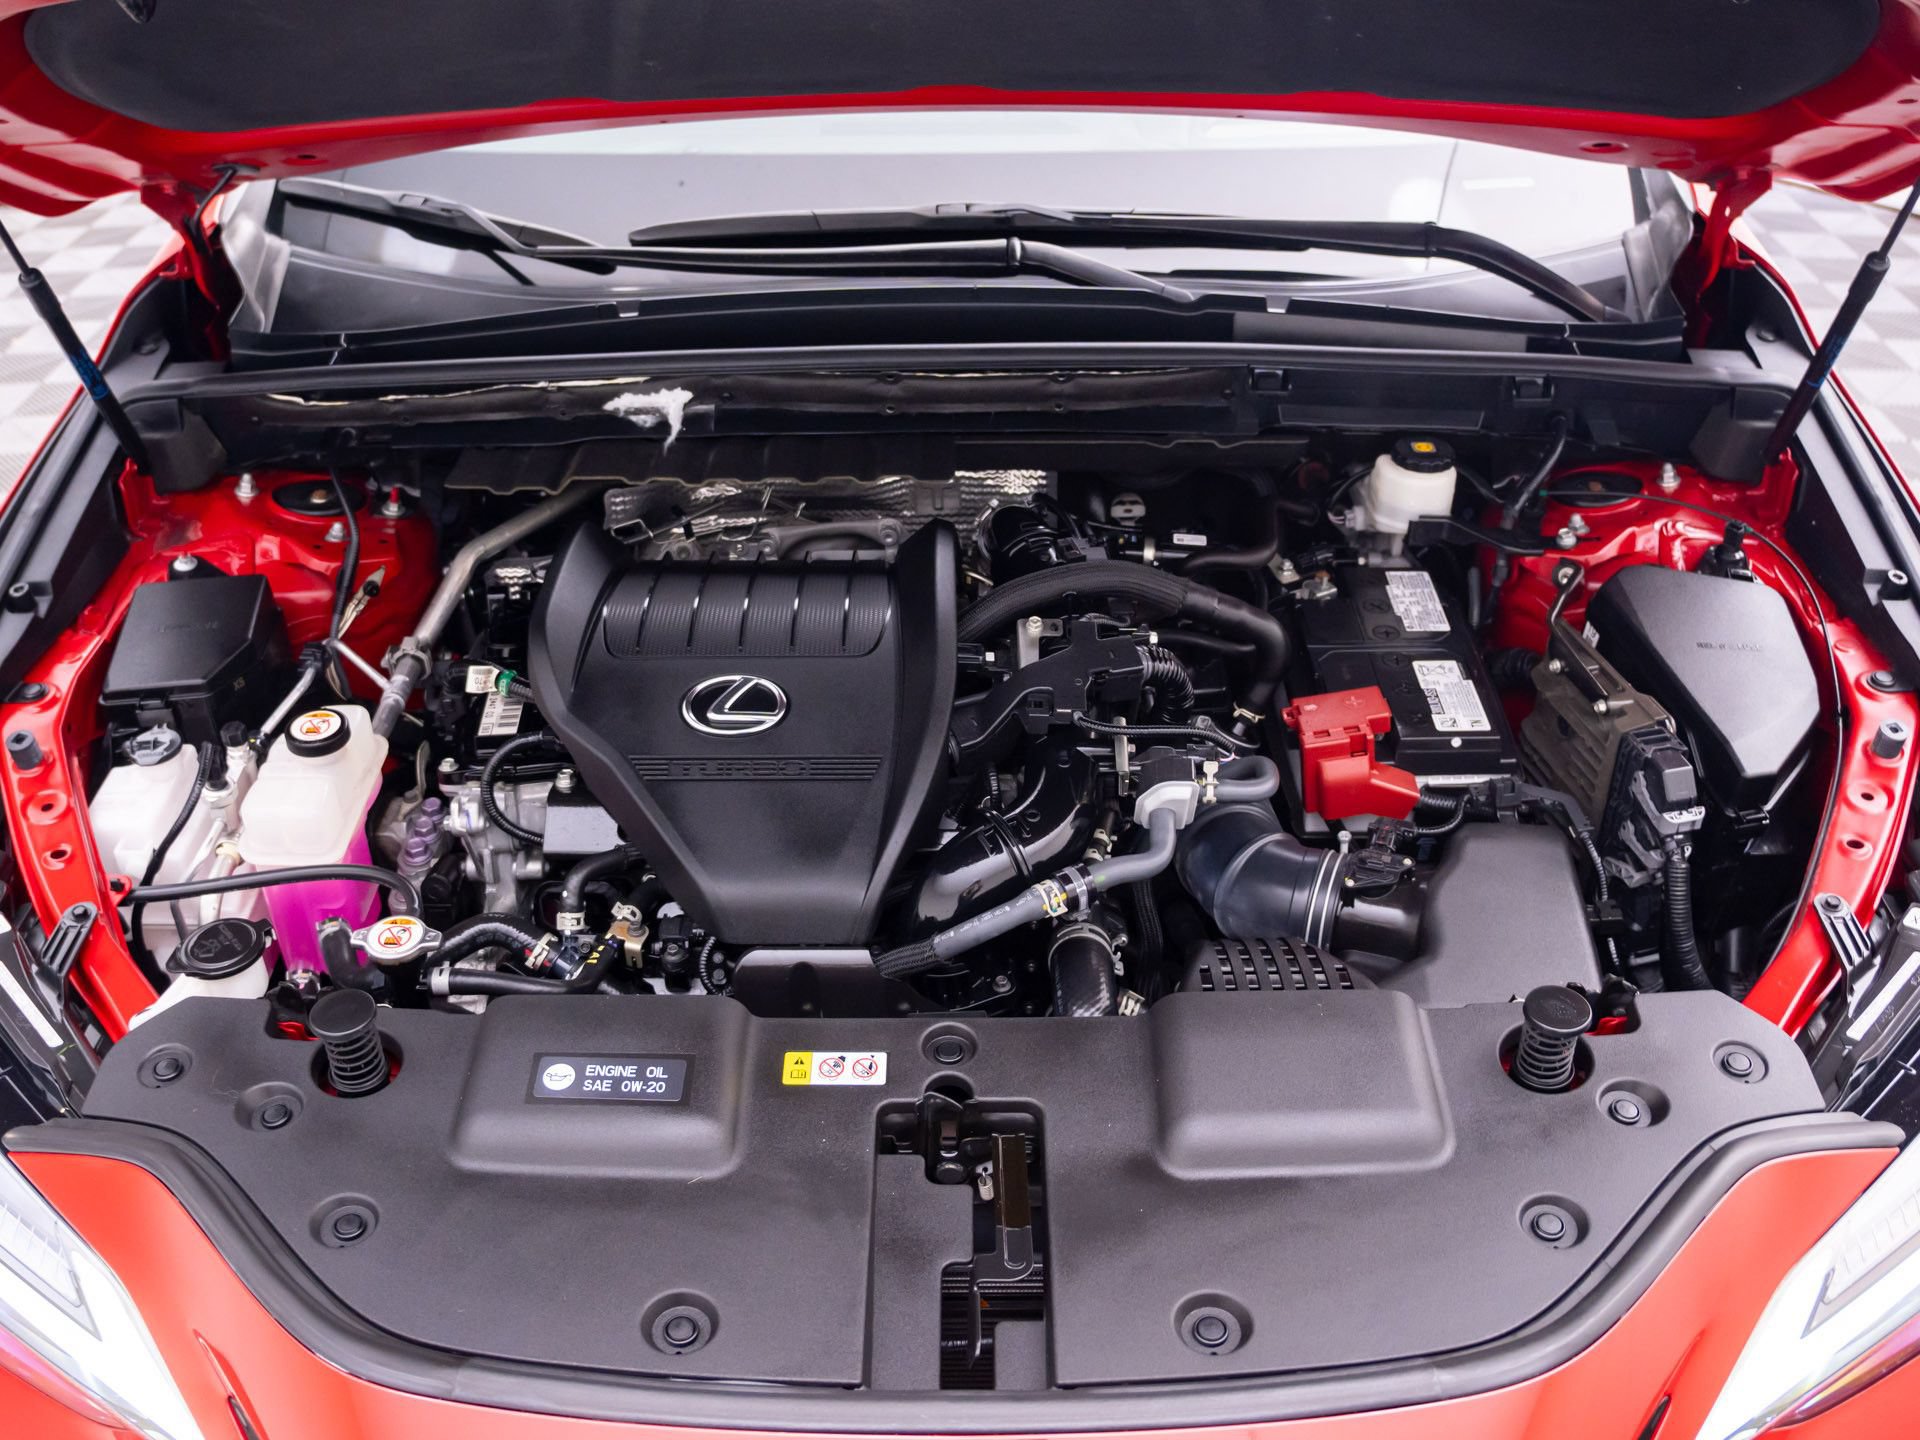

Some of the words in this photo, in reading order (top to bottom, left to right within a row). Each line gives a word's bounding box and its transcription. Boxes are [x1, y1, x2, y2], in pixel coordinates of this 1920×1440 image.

[670, 759, 808, 777] TURBO
[585, 1064, 637, 1078] ENGINE
[646, 1066, 668, 1079] OIL
[582, 1079, 612, 1092] SAE
[621, 1080, 666, 1093] 0W-20
